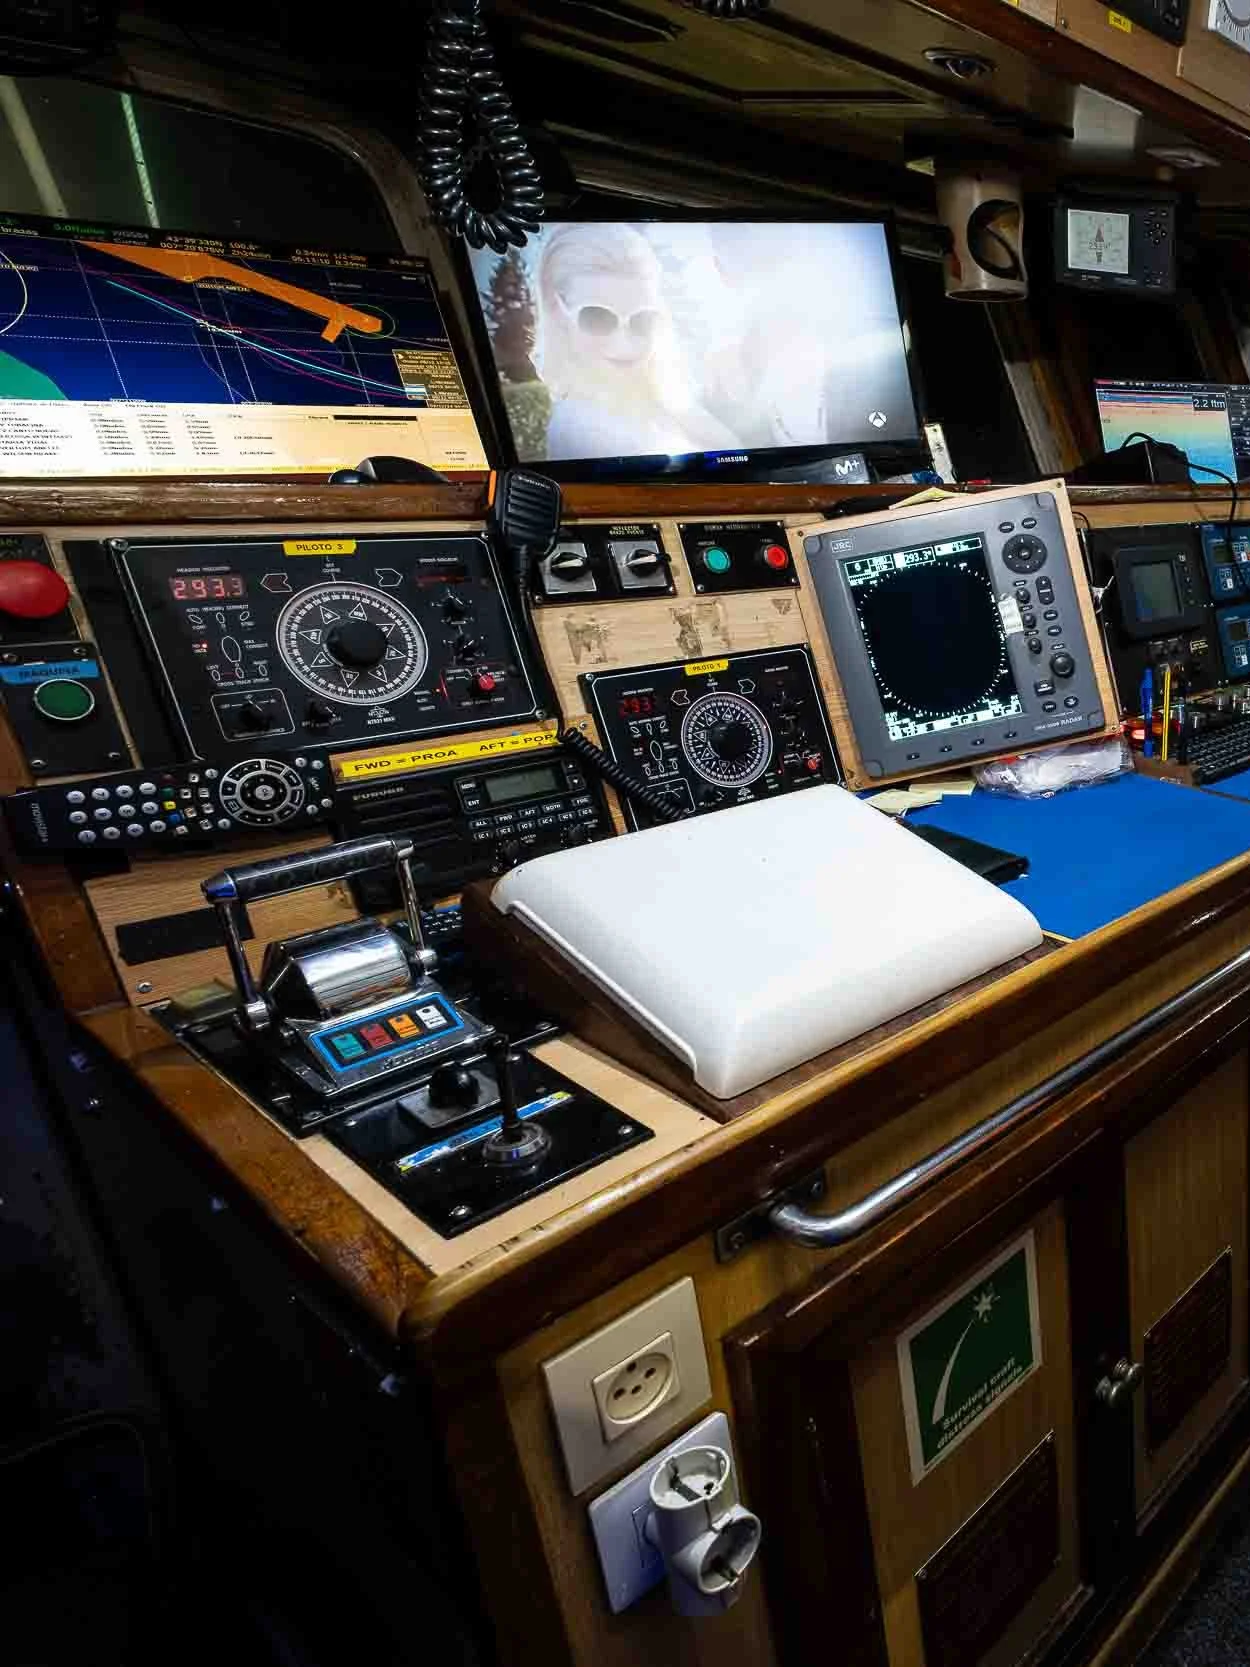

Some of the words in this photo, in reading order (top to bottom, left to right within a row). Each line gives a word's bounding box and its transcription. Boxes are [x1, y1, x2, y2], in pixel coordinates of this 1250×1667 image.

[716, 455, 749, 464] SAMSUNG
[296, 543, 332, 551] PILOTO
[833, 540, 852, 551] JRC
[692, 664, 714, 672] PILOTO
[354, 759, 391, 772] FWD
[411, 749, 457, 763] PROA
[479, 741, 507, 752] AFT
[524, 734, 555, 744] POP
[943, 1382, 988, 1430] Survival
[989, 1357, 1016, 1385] craft
